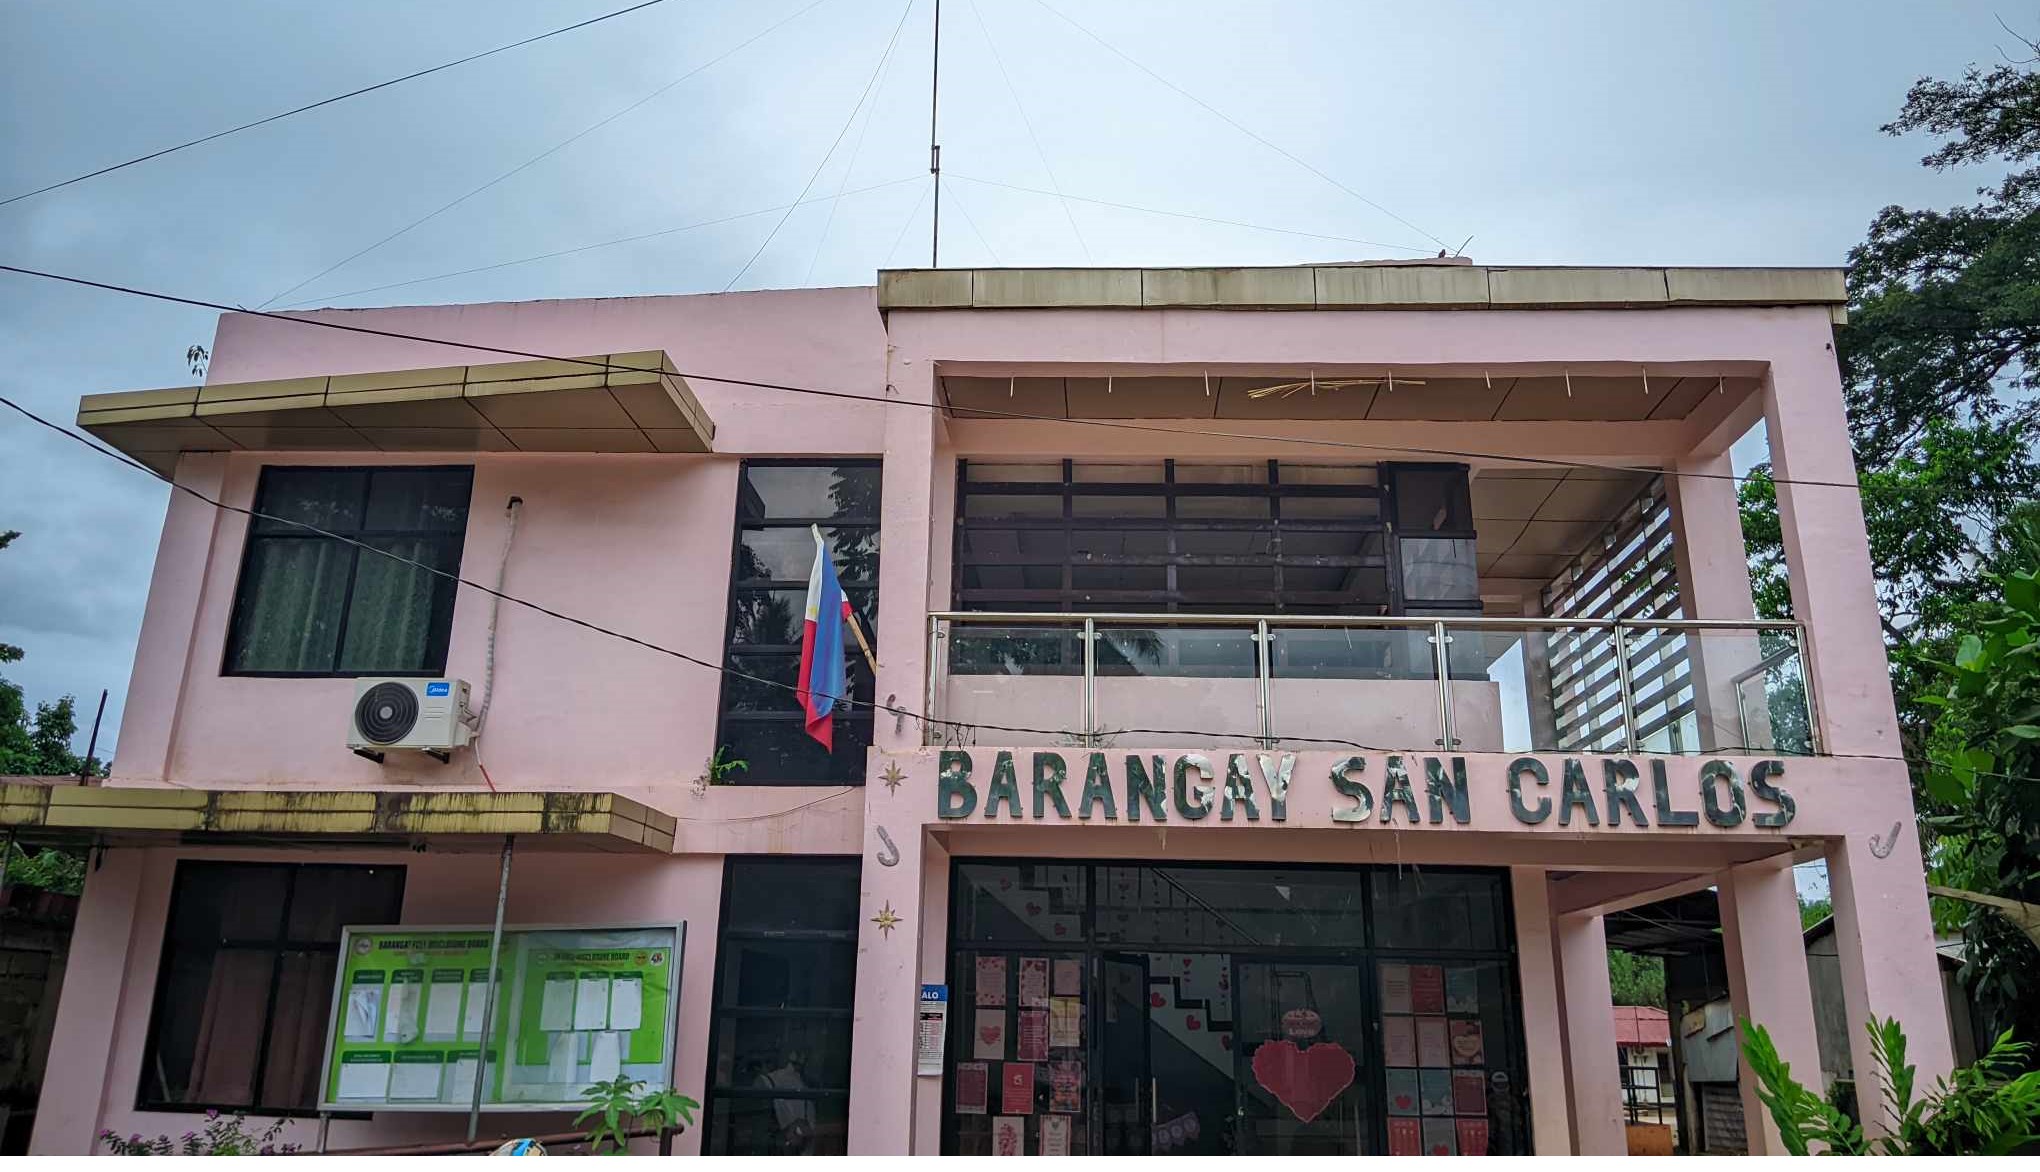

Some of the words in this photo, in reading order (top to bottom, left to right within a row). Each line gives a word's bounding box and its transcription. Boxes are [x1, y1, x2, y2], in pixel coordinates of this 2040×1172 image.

[938, 751, 1297, 822] BARANGAY
[1329, 756, 1471, 824] SAN
[1506, 757, 1797, 828] CARLOS
